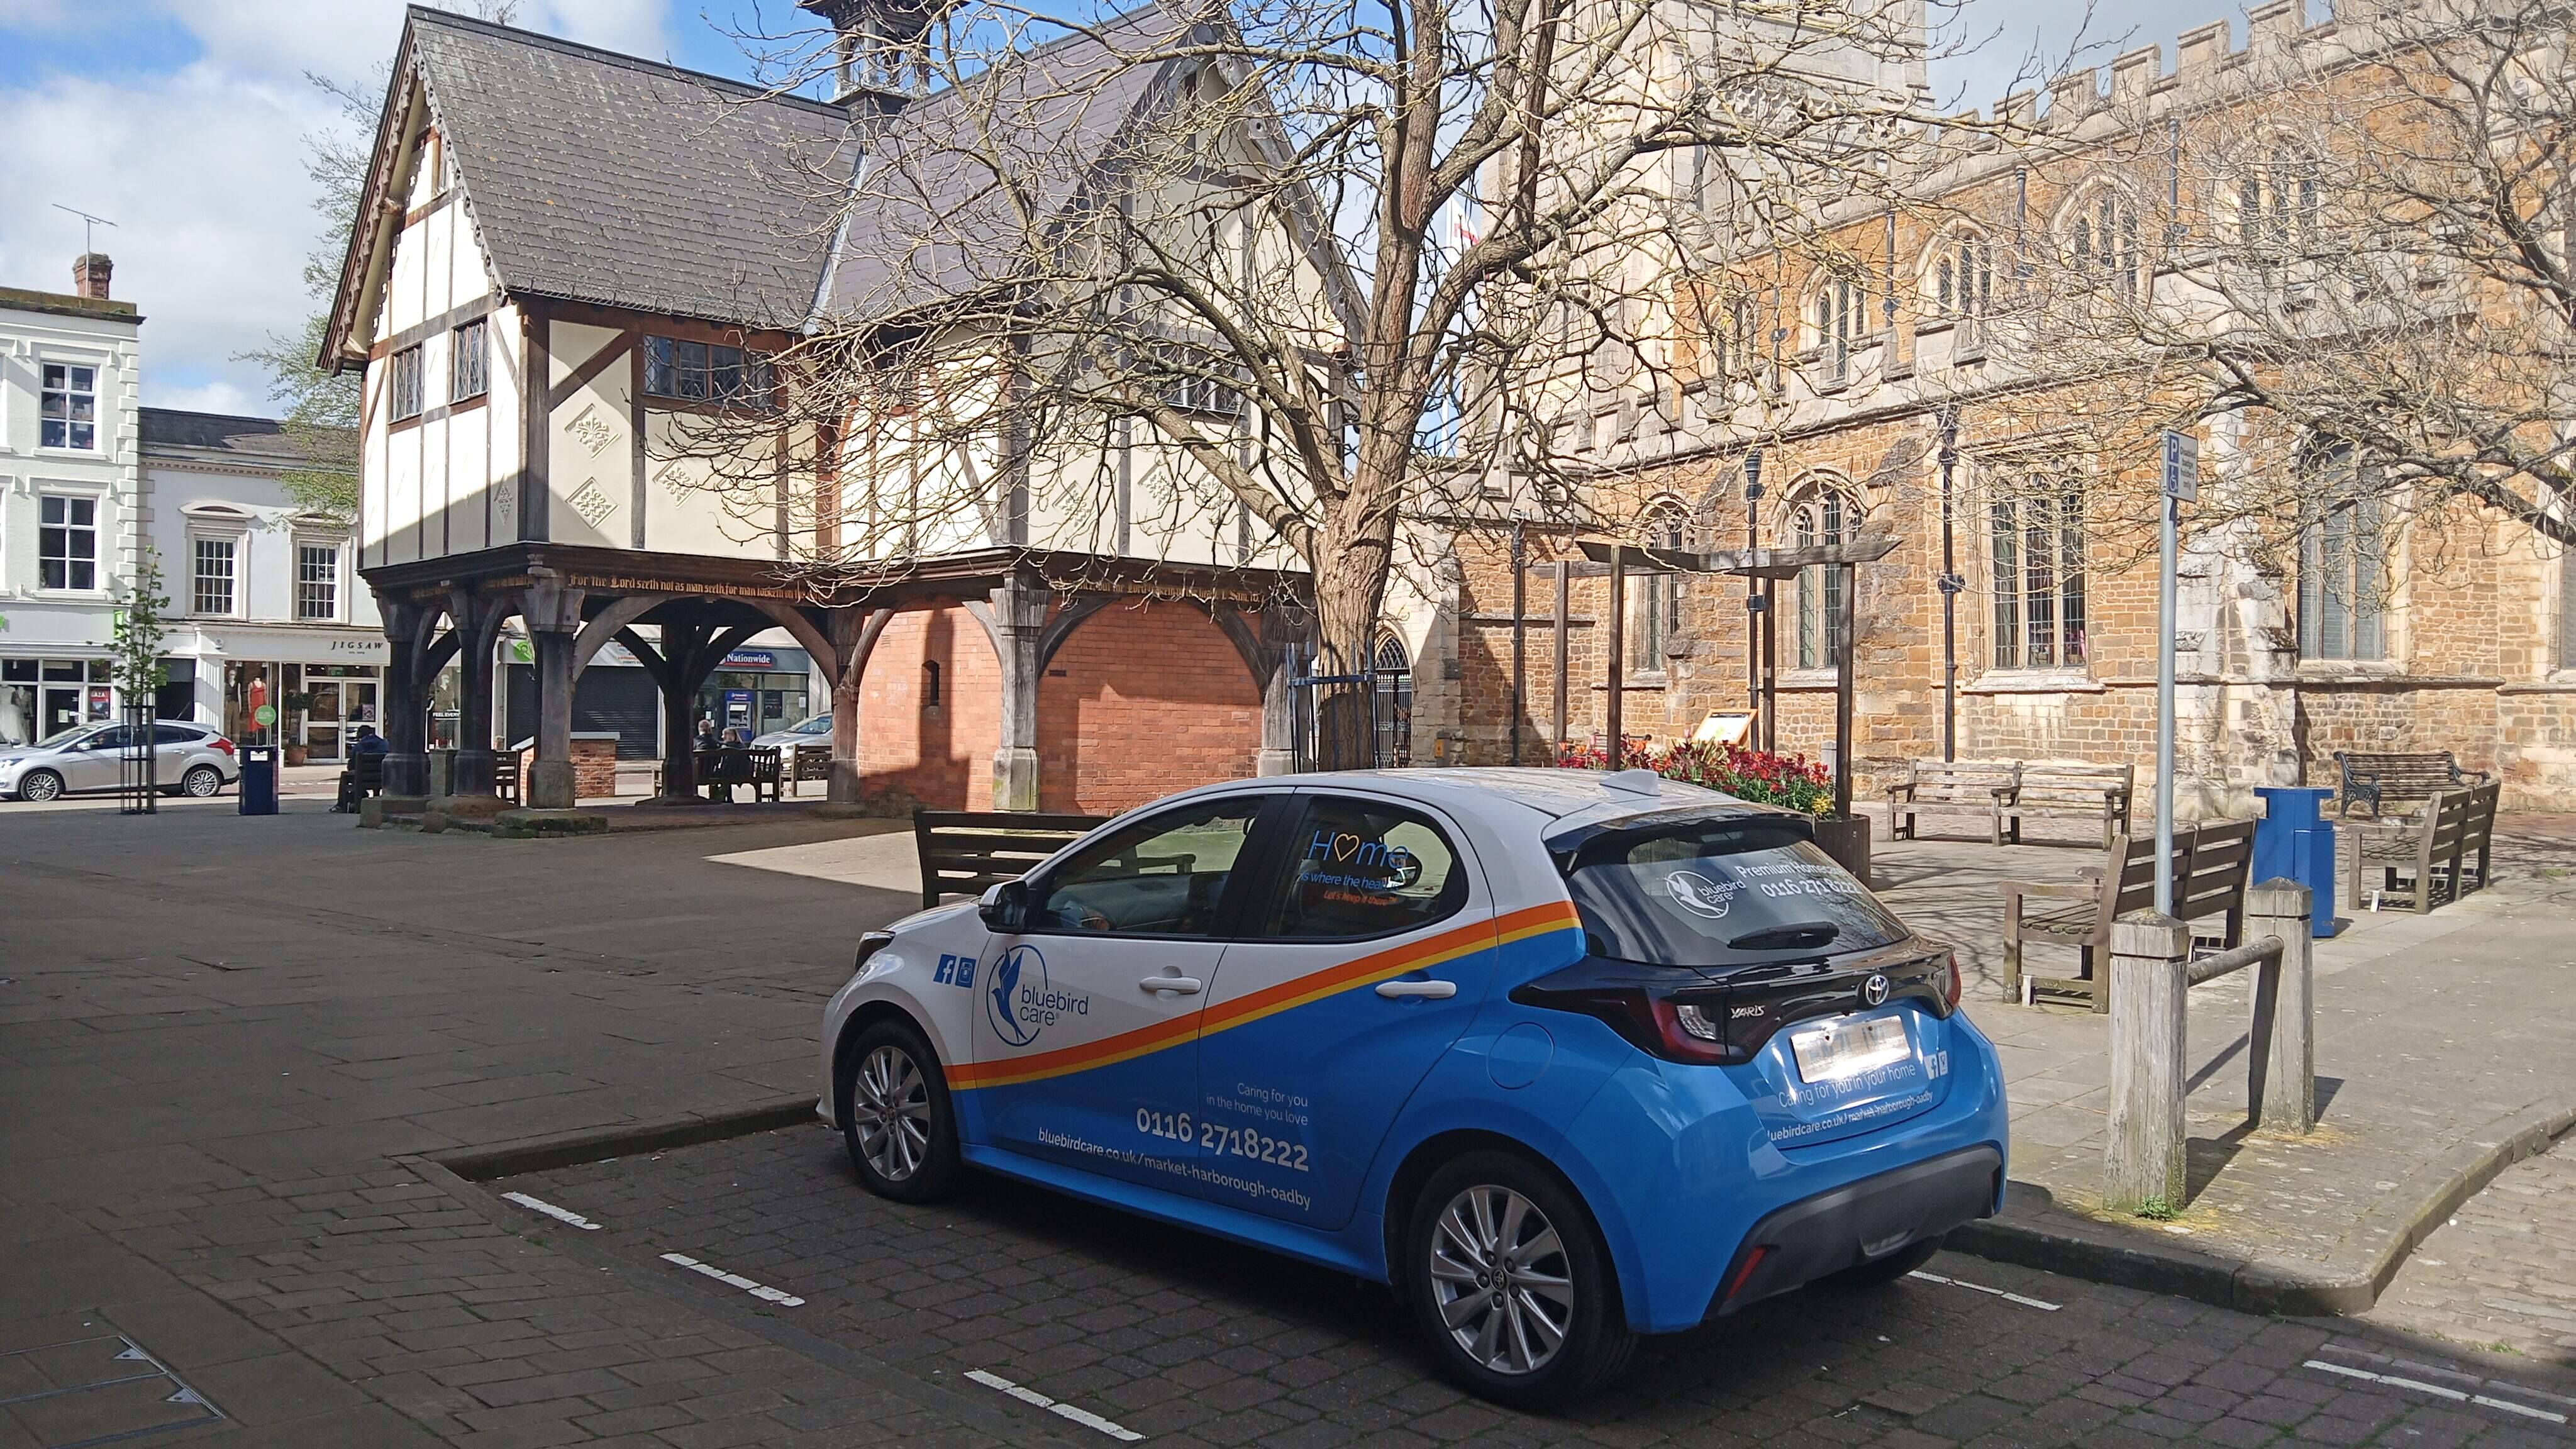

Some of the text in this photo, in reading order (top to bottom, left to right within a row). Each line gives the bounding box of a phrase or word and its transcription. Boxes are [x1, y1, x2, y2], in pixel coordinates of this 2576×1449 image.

[2170, 438, 2178, 460] P
[569, 573, 589, 587] For
[610, 575, 635, 588] Lord
[637, 578, 658, 590] seeth
[661, 581, 674, 590] not
[675, 582, 684, 591] as
[686, 583, 704, 593] man
[739, 586, 755, 596] man
[331, 641, 383, 650] JIGSAW
[727, 653, 770, 663] Nationwide
[1311, 872, 1341, 885] where
[1343, 874, 1360, 887] the
[1735, 863, 1794, 879] Premium
[1324, 890, 1340, 900] Let's
[1341, 892, 1360, 903] keep
[1697, 879, 1746, 897] bluebird
[1761, 879, 1802, 897] 0116
[1021, 984, 1089, 1015] bluebird
[1731, 1005, 1765, 1019] YARIS
[1815, 1083, 1829, 1102] for
[1831, 1077, 1853, 1099] you
[1855, 1076, 1863, 1091] in
[1862, 1071, 1887, 1092] your
[1888, 1064, 1916, 1079] home
[1238, 1082, 1308, 1108] Caring for you
[1207, 1095, 1309, 1126] in the home you love
[1136, 1108, 1309, 1172] 0116 2718222
[1038, 1127, 1311, 1211] bluebirdcare.co.uk/market-harborough-oadby
